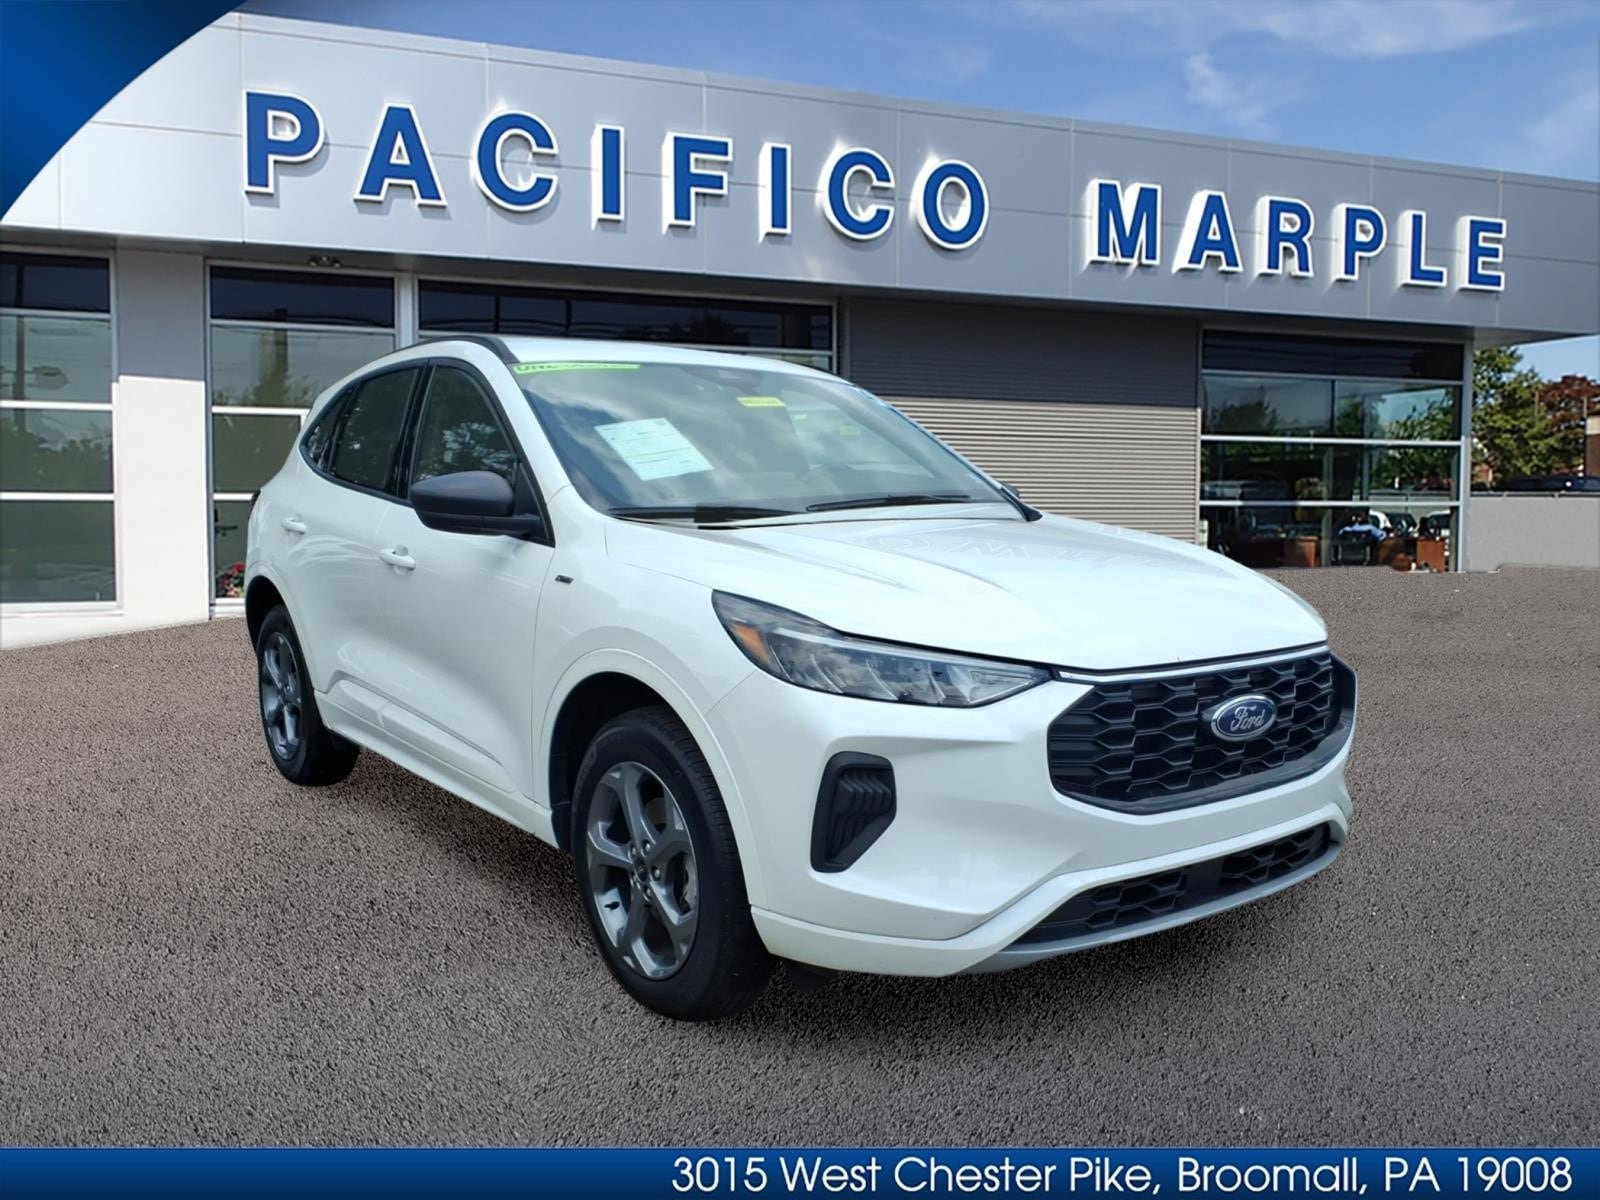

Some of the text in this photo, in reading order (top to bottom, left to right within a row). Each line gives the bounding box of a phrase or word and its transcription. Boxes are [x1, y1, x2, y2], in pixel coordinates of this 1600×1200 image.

[243, 90, 1506, 290] PACIFICO MARPLE
[1230, 705, 1266, 731] Ford
